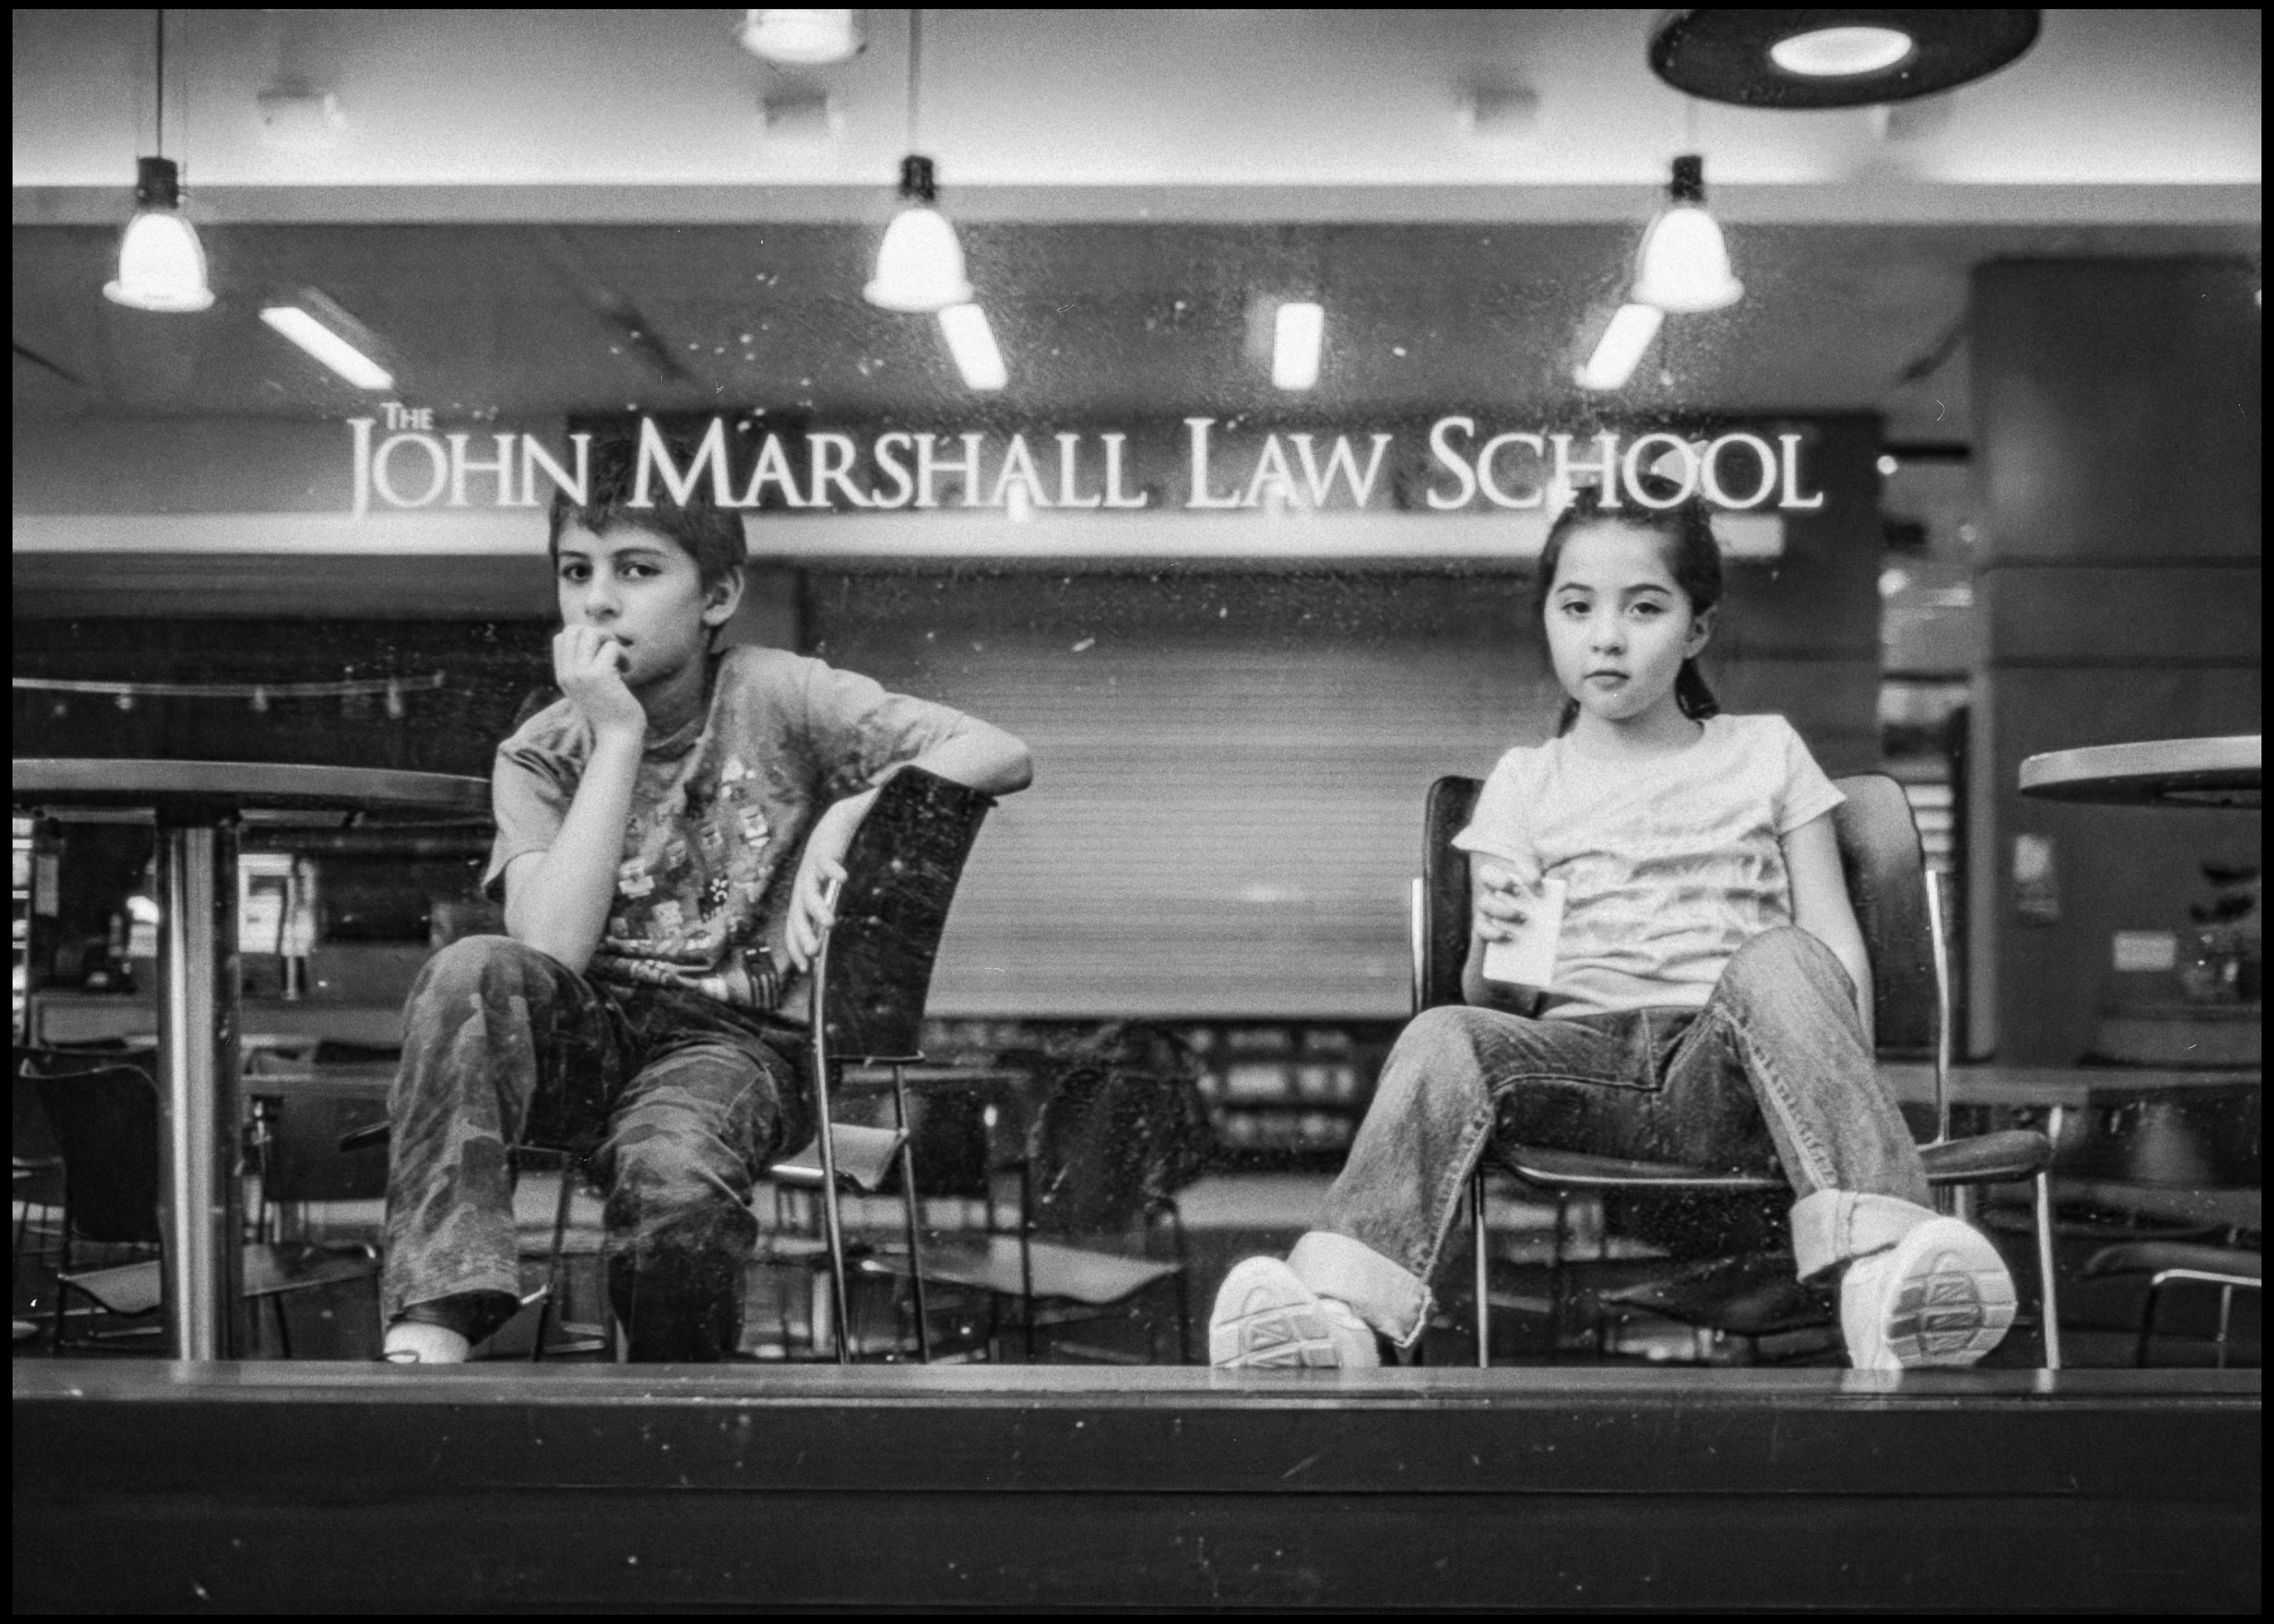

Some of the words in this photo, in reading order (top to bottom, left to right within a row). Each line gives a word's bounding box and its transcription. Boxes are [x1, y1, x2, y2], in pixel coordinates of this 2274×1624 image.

[379, 402, 433, 430] THE
[347, 418, 591, 520] JOHN
[627, 416, 1148, 509] MARSHALL
[1183, 418, 1394, 508] LAW
[1426, 416, 1824, 509] SCHOOL
